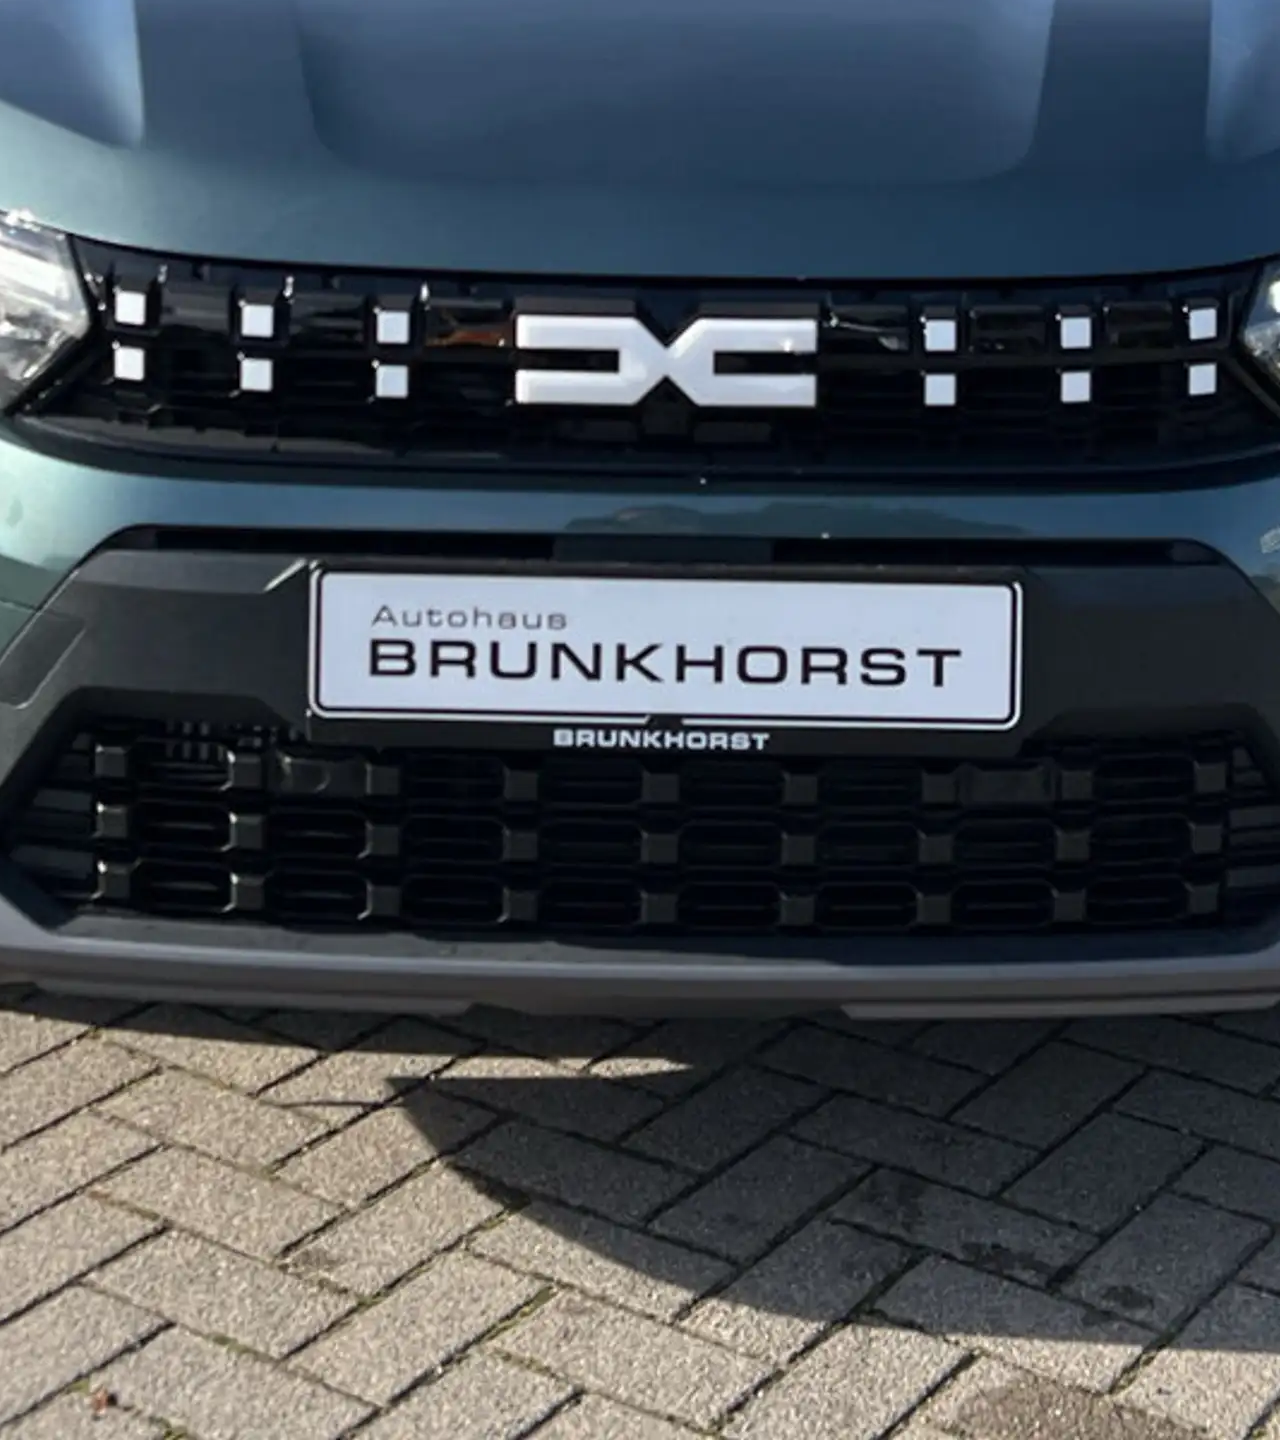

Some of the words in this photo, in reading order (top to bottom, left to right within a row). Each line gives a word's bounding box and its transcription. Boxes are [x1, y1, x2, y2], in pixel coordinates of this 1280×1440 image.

[370, 604, 568, 631] Autohaus
[368, 637, 962, 689] BRUNKHORST
[553, 728, 770, 751] BRUNKHORST
